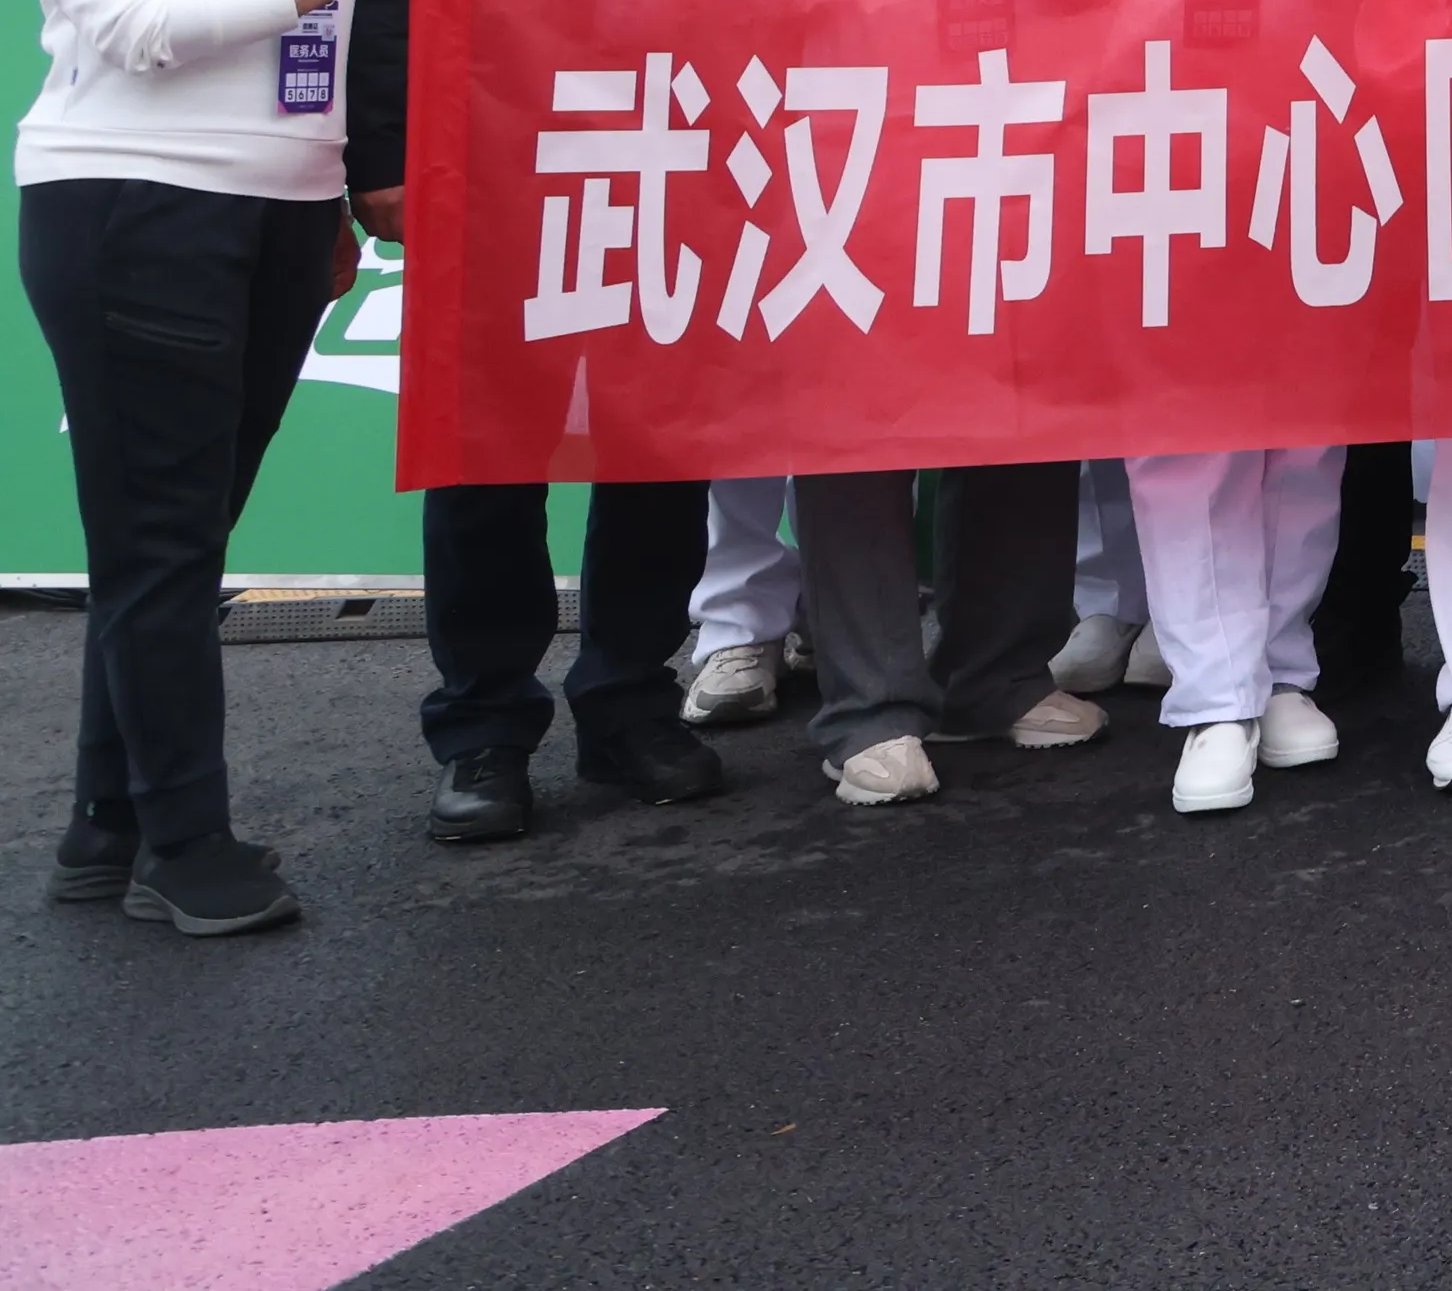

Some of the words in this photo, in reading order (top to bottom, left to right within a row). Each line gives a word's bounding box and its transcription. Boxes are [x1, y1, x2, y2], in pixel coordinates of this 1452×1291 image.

[289, 44, 329, 59] 医务人员
[287, 89, 294, 101] 5
[298, 89, 305, 101] 6
[309, 89, 316, 100] 7
[320, 89, 327, 100] 8
